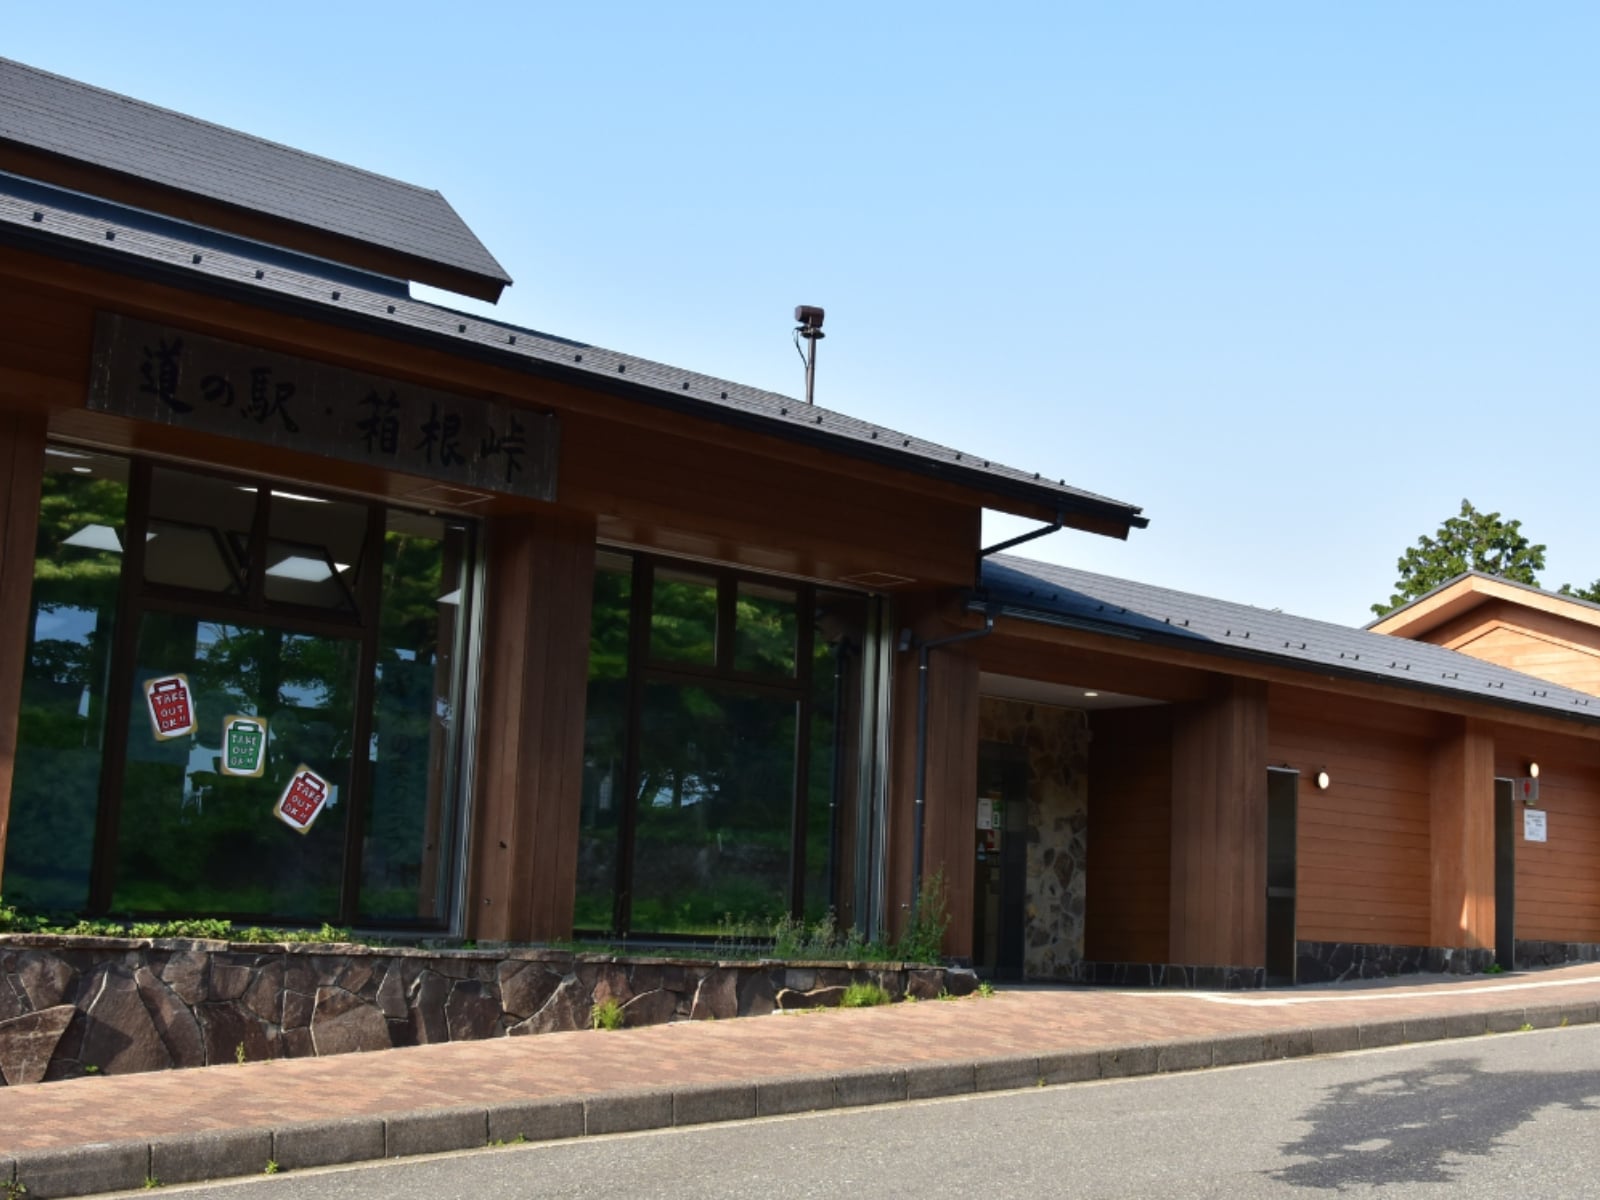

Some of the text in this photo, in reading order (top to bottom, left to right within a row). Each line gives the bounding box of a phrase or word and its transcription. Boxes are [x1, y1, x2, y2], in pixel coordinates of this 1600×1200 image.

[154, 691, 185, 705] TAKE
[160, 704, 184, 718] OUT
[231, 734, 257, 746] TAKE
[232, 746, 255, 757] OUT
[296, 782, 321, 804] TAKE
[291, 794, 313, 812] OUT
